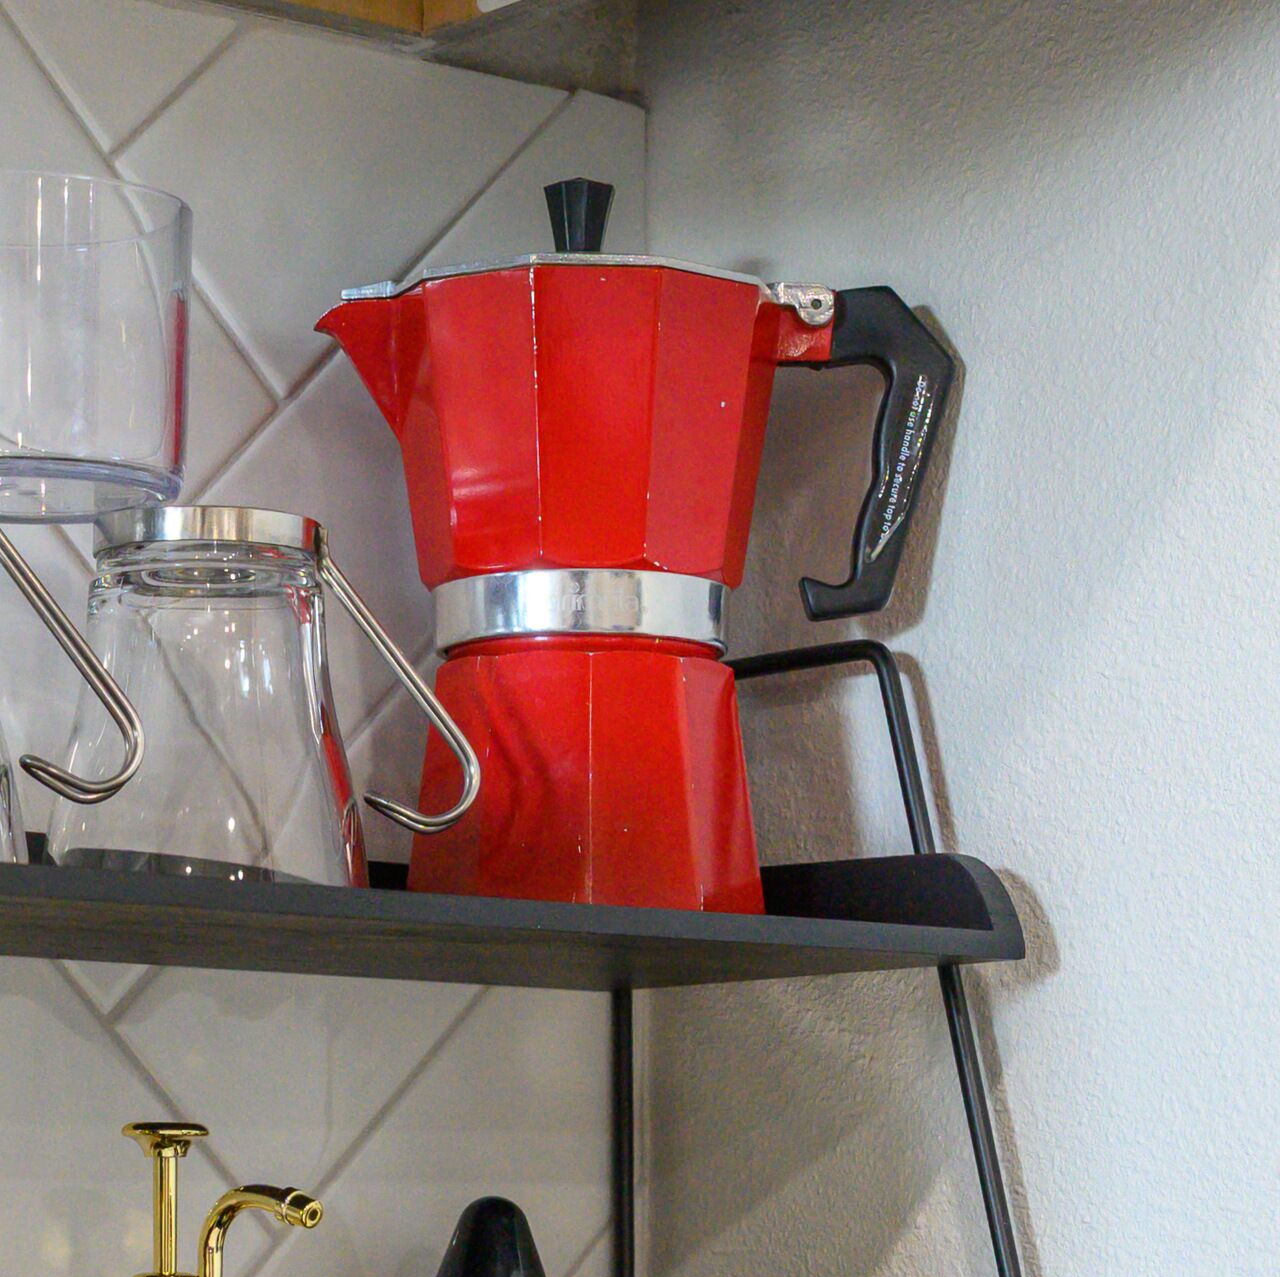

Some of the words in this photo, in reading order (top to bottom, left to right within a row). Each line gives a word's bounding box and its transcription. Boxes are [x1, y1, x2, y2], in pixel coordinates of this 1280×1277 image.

[907, 411, 916, 428] use
[899, 428, 915, 460] handle
[896, 462, 906, 472] to
[889, 473, 902, 502] secure
[883, 504, 896, 520] top
